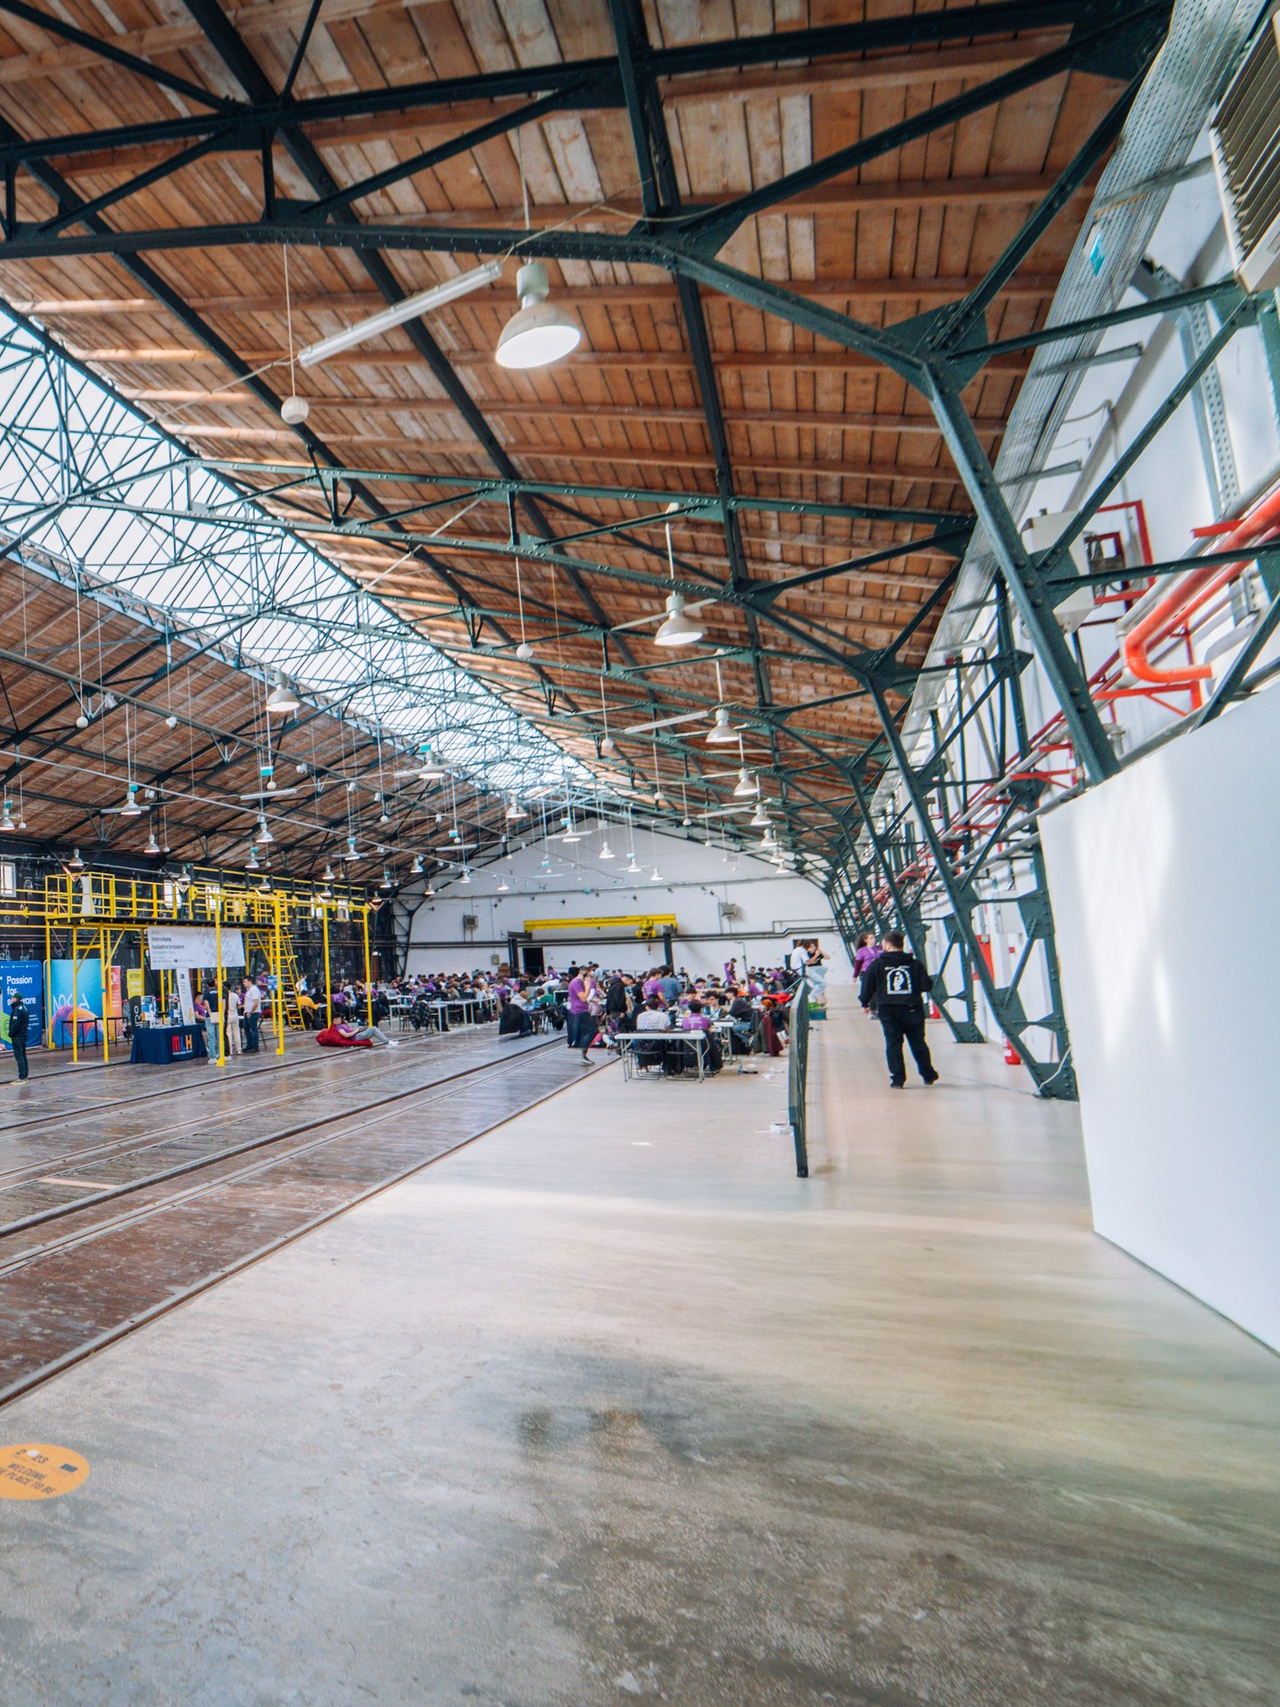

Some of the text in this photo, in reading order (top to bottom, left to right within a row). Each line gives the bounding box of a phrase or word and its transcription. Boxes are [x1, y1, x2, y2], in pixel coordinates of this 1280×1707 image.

[6, 975, 33, 985] Passion
[172, 1034, 193, 1051] MLH
[7, 1463, 49, 1481] WELCOME
[4, 1471, 34, 1486] PLACE
[31, 1481, 45, 1490] TO
[41, 1486, 56, 1495] BE
